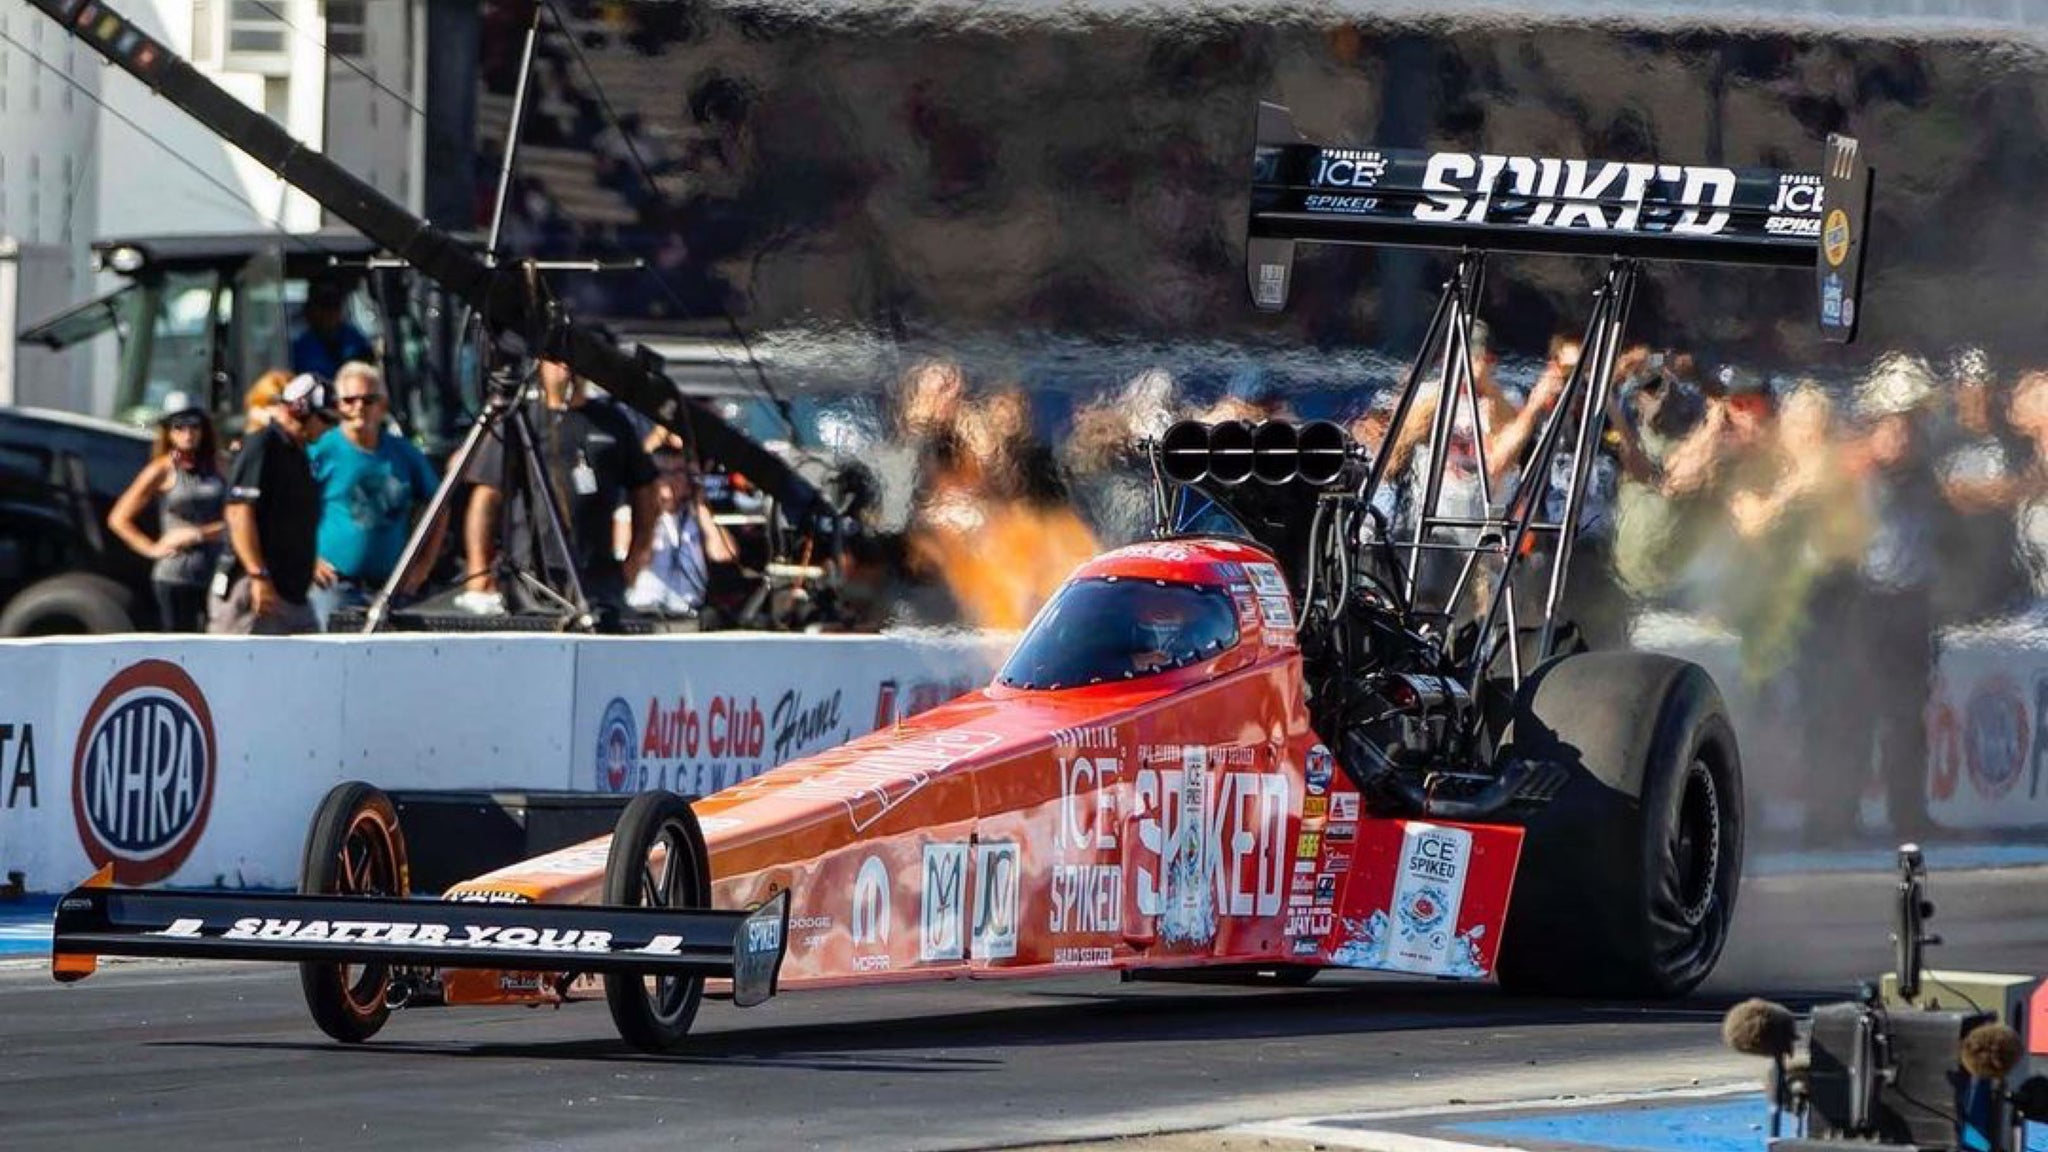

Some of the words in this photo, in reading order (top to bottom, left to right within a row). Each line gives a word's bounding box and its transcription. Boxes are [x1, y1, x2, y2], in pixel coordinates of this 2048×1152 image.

[1315, 160, 1387, 187] ICE
[1305, 196, 1378, 208] SPIKED
[1412, 152, 1736, 235] SPIKED
[641, 696, 699, 758] Auto
[708, 696, 763, 758] Club
[94, 704, 194, 842] NHRA
[1053, 758, 1117, 849] ICE
[1416, 838, 1455, 861] ICE
[1409, 856, 1455, 879] SPIKED
[1051, 864, 1121, 932] SPIKED
[221, 918, 450, 944] SHATTER
[452, 925, 613, 952] YOUR
[789, 916, 831, 929] DODGE
[852, 955, 889, 971] MOPAR
